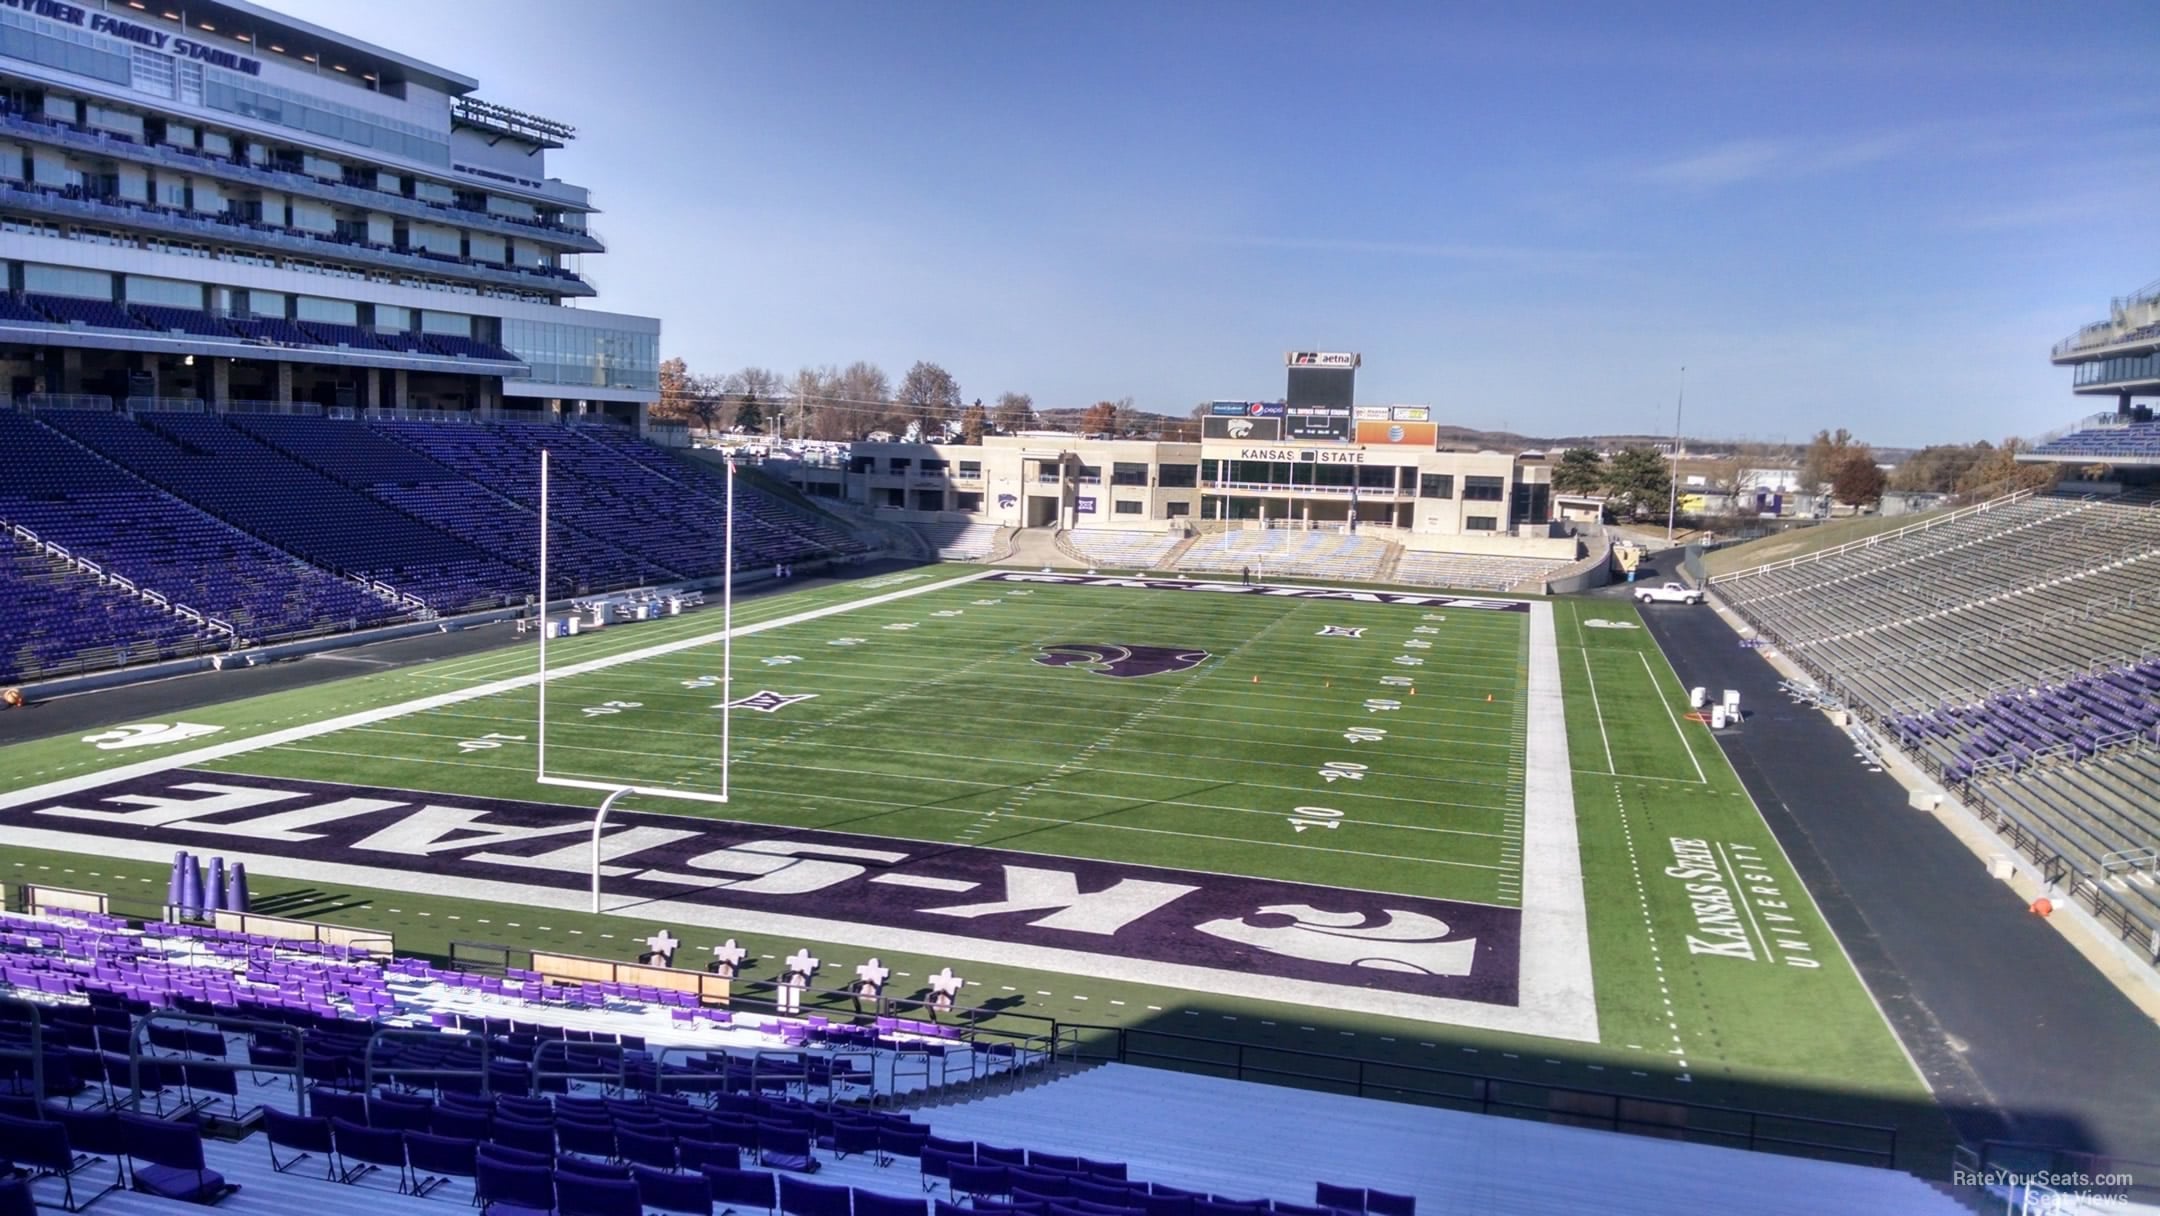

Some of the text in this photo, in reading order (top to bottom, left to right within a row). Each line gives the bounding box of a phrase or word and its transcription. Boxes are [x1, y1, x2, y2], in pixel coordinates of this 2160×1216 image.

[0, 0, 262, 76] YDER FAMILY STADIUM
[1322, 354, 1350, 363] aetna
[1241, 449, 1364, 463] KANSAS STATE
[458, 733, 526, 749] 10
[1318, 761, 1369, 780] 20
[1287, 806, 1345, 829] 10
[32, 782, 1201, 934] K-STATE
[1664, 837, 1757, 961] KANSAS STATE
[1729, 842, 1821, 968] UNIVERSITY
